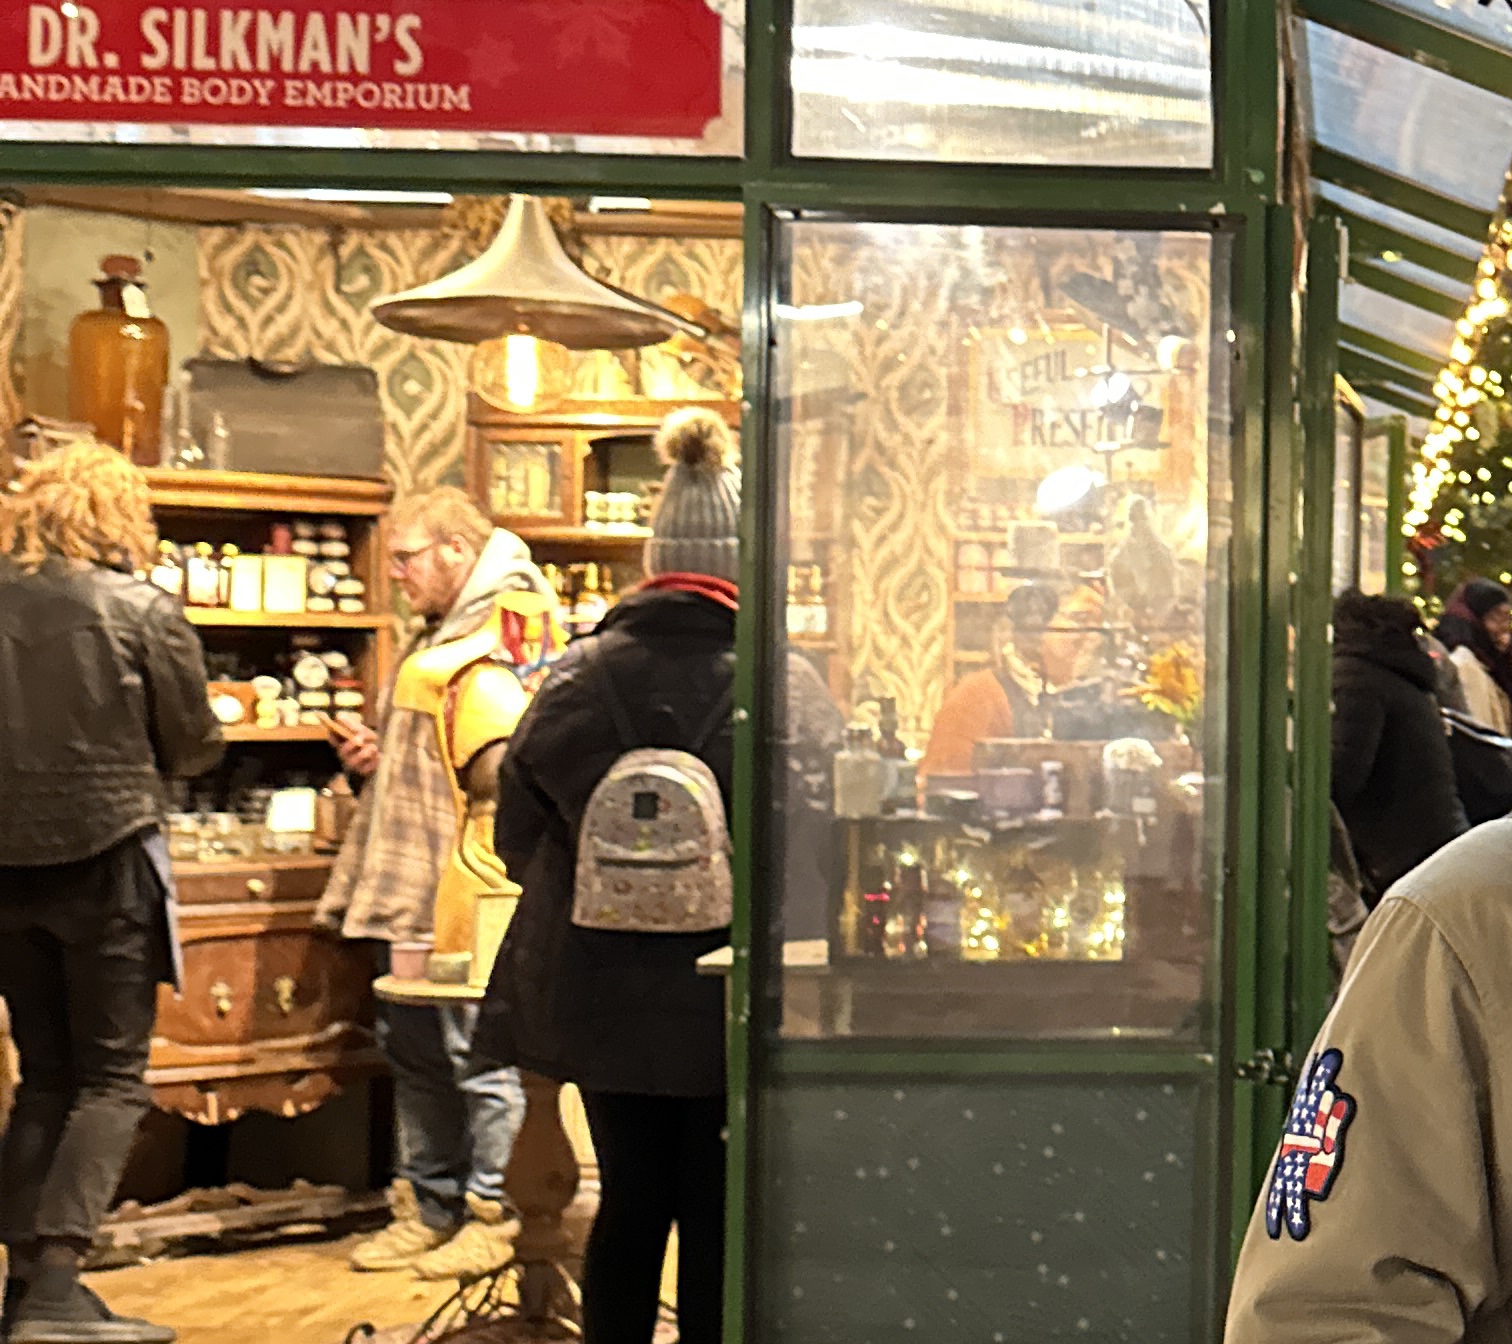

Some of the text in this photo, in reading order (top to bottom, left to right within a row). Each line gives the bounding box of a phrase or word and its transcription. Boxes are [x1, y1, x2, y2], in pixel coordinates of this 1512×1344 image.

[28, 4, 424, 77] DR. SILKMAN'S
[0, 72, 473, 112] ANDMADE BODY EMPORIUM
